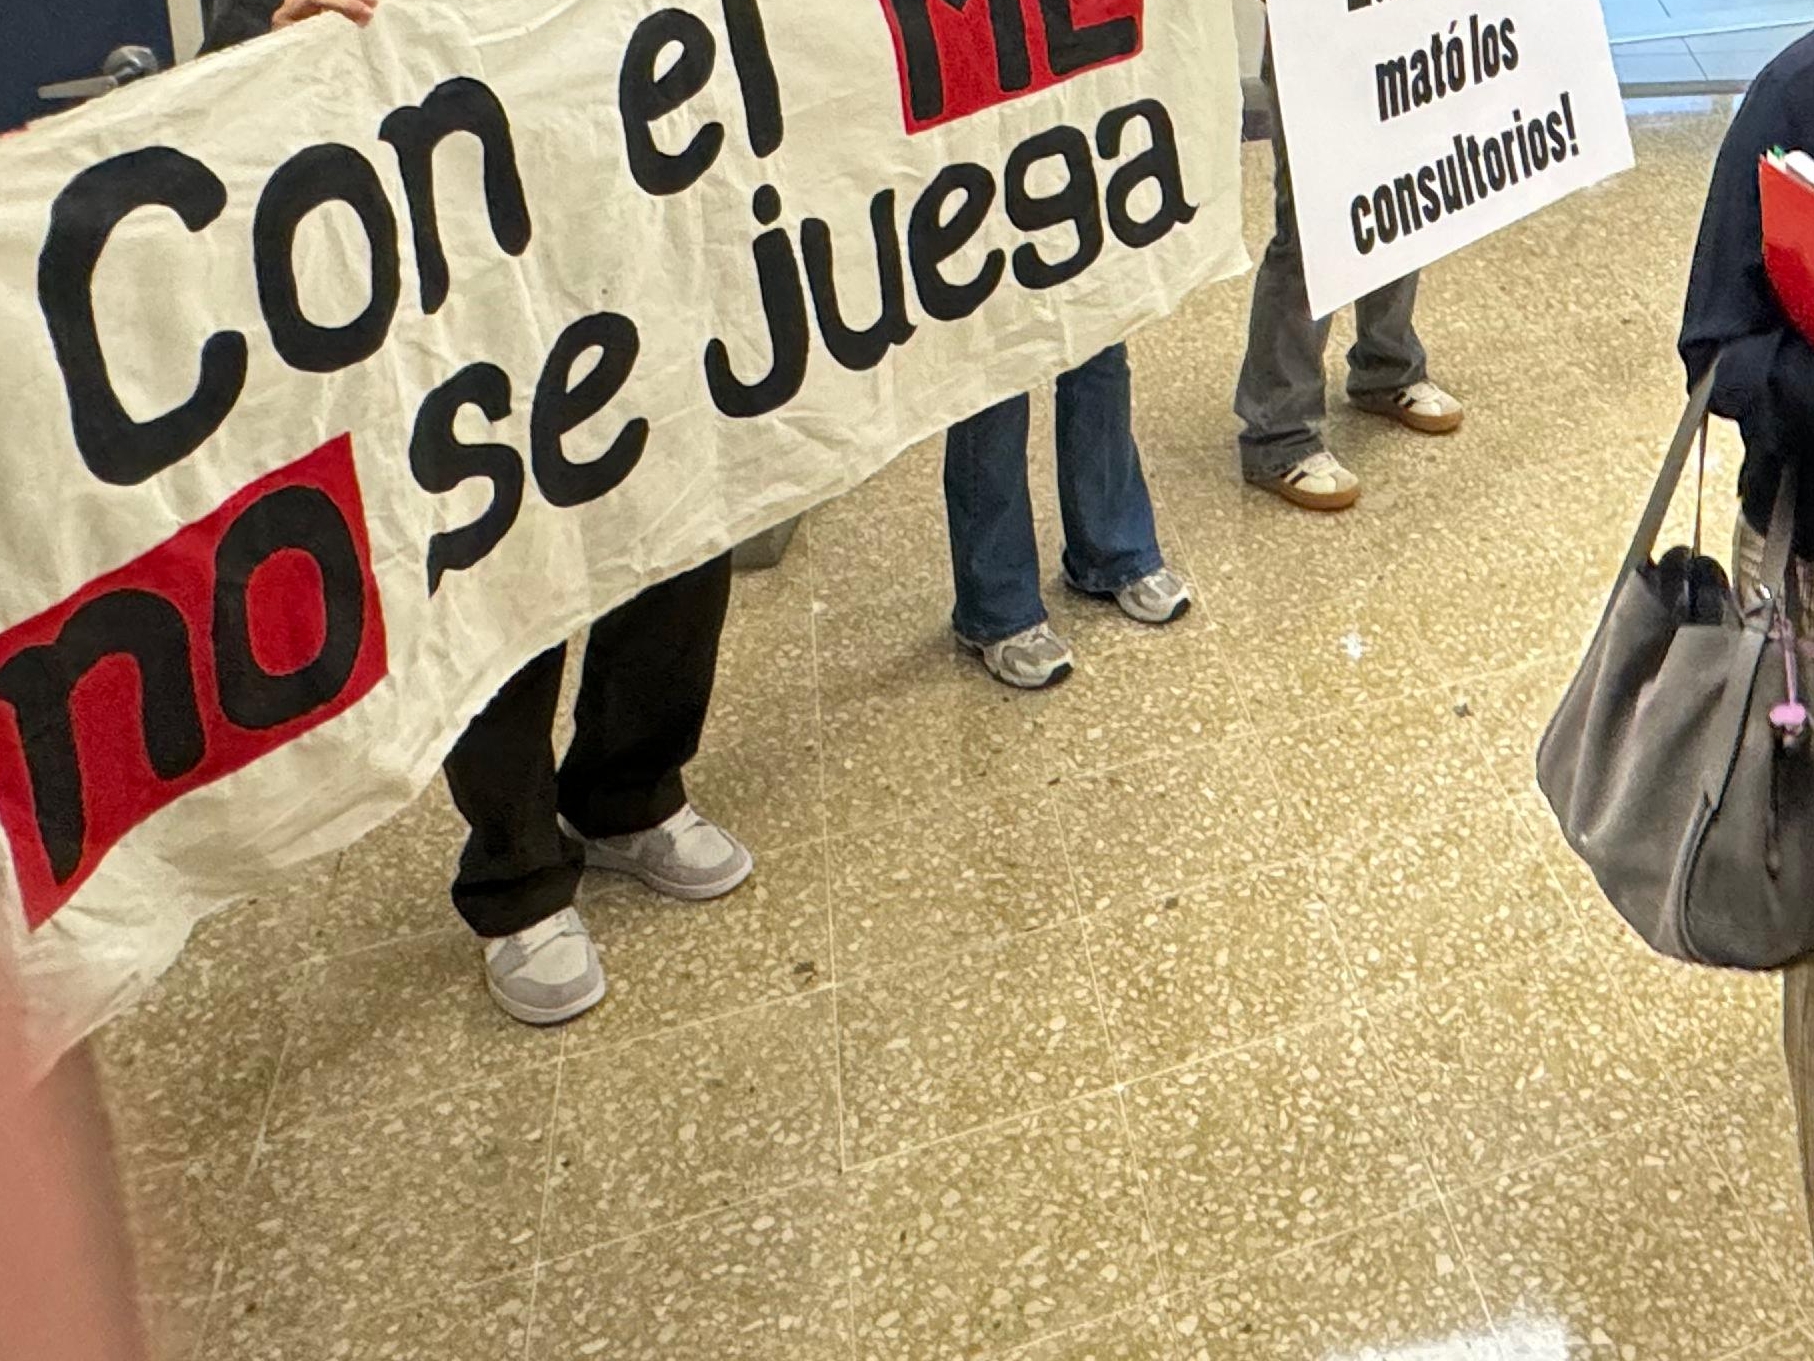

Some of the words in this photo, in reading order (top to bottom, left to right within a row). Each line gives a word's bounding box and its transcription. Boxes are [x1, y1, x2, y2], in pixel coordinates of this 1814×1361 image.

[1350, 92, 1580, 255] consultorios!
[1375, 20, 1467, 122] mató
[1469, 14, 1519, 85] los
[38, 77, 531, 486] Con
[0, 484, 365, 886] no
[410, 312, 650, 598] se
[704, 98, 1200, 418] juega
